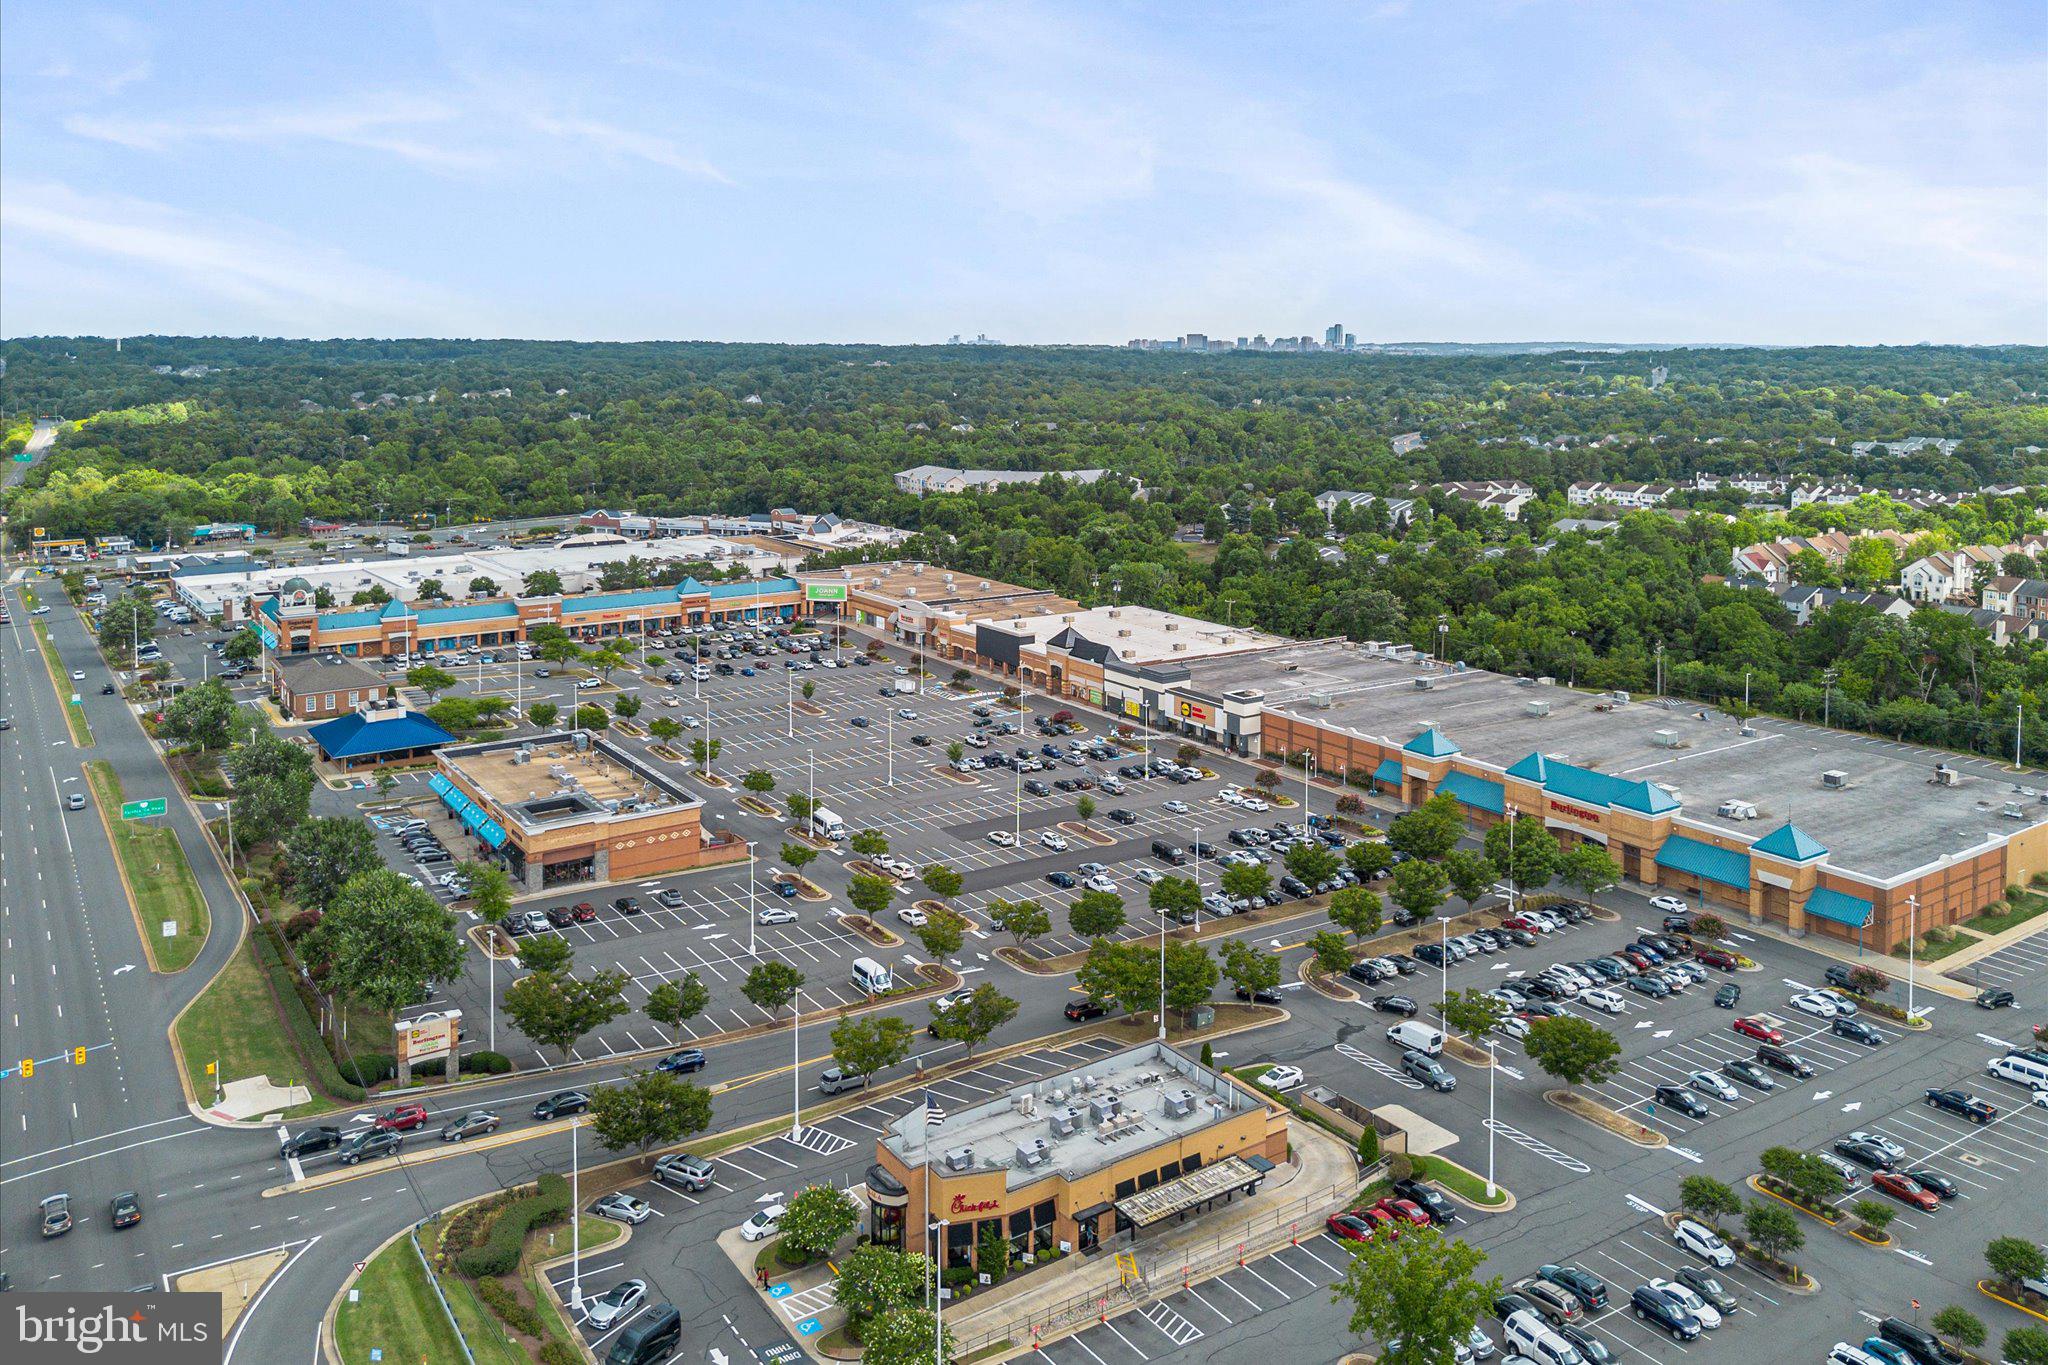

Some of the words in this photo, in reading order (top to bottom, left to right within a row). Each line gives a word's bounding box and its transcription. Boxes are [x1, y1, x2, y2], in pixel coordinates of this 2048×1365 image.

[1551, 800, 1599, 823] Burlington
[413, 1034, 446, 1044] Burlington
[1626, 1200, 1649, 1213] STOP
[764, 1343, 794, 1357] THRU
